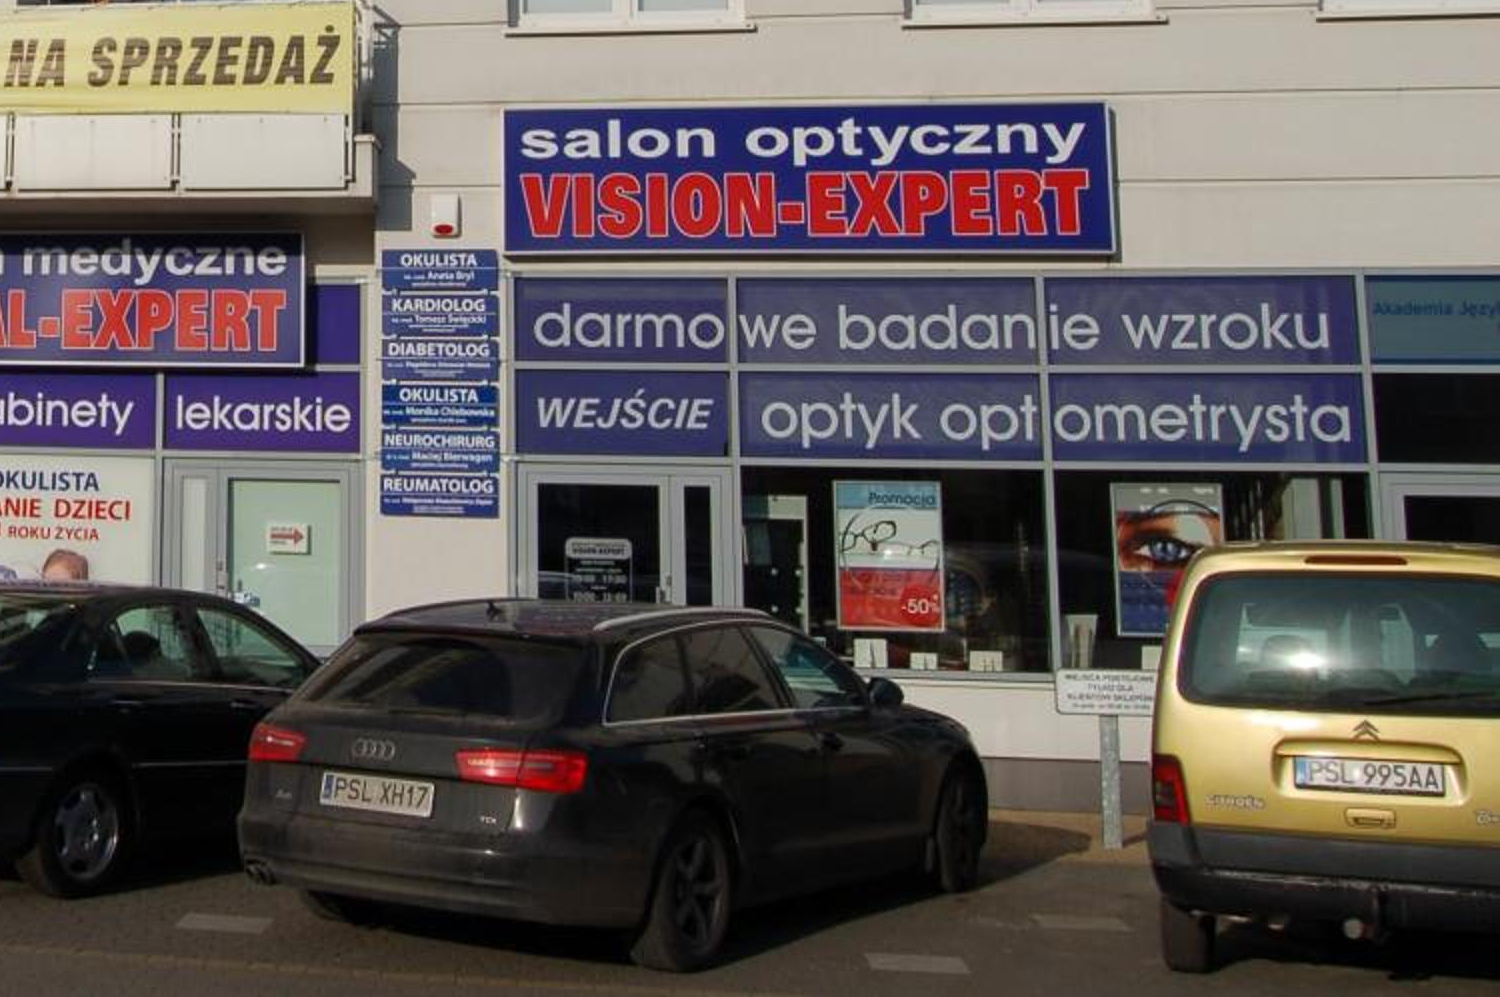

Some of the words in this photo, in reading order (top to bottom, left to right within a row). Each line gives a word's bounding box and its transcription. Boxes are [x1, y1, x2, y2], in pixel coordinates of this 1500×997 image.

[2, 38, 67, 88] NA
[86, 25, 341, 88] SPRZEDAŻ
[520, 119, 717, 159] salon
[744, 118, 1087, 167] optyczny
[519, 169, 1091, 238] VISION-EXPERT
[22, 237, 289, 286] medyczne
[400, 253, 478, 267] OKULISTA
[391, 298, 486, 312] KARDIOLOG
[838, 304, 1099, 350] badanie
[1121, 302, 1330, 350] wzroku
[388, 342, 491, 357] DIABETOLOG
[399, 388, 479, 403] OKULISTA
[537, 388, 713, 430] WEJŚCIE
[175, 396, 351, 432] lekarskie
[761, 392, 921, 450] optyk
[940, 394, 1351, 452] optometrysta
[384, 434, 495, 448] NEUROCHIRURG
[383, 478, 495, 493] REUMATOLOG
[54, 499, 131, 521] DZIECI
[868, 492, 936, 508] Promocja
[8, 526, 50, 539] ROKU
[1309, 762, 1353, 786] PSL
[1363, 762, 1440, 789] 995AA
[334, 779, 371, 802] PSL
[380, 785, 429, 809] XH17
